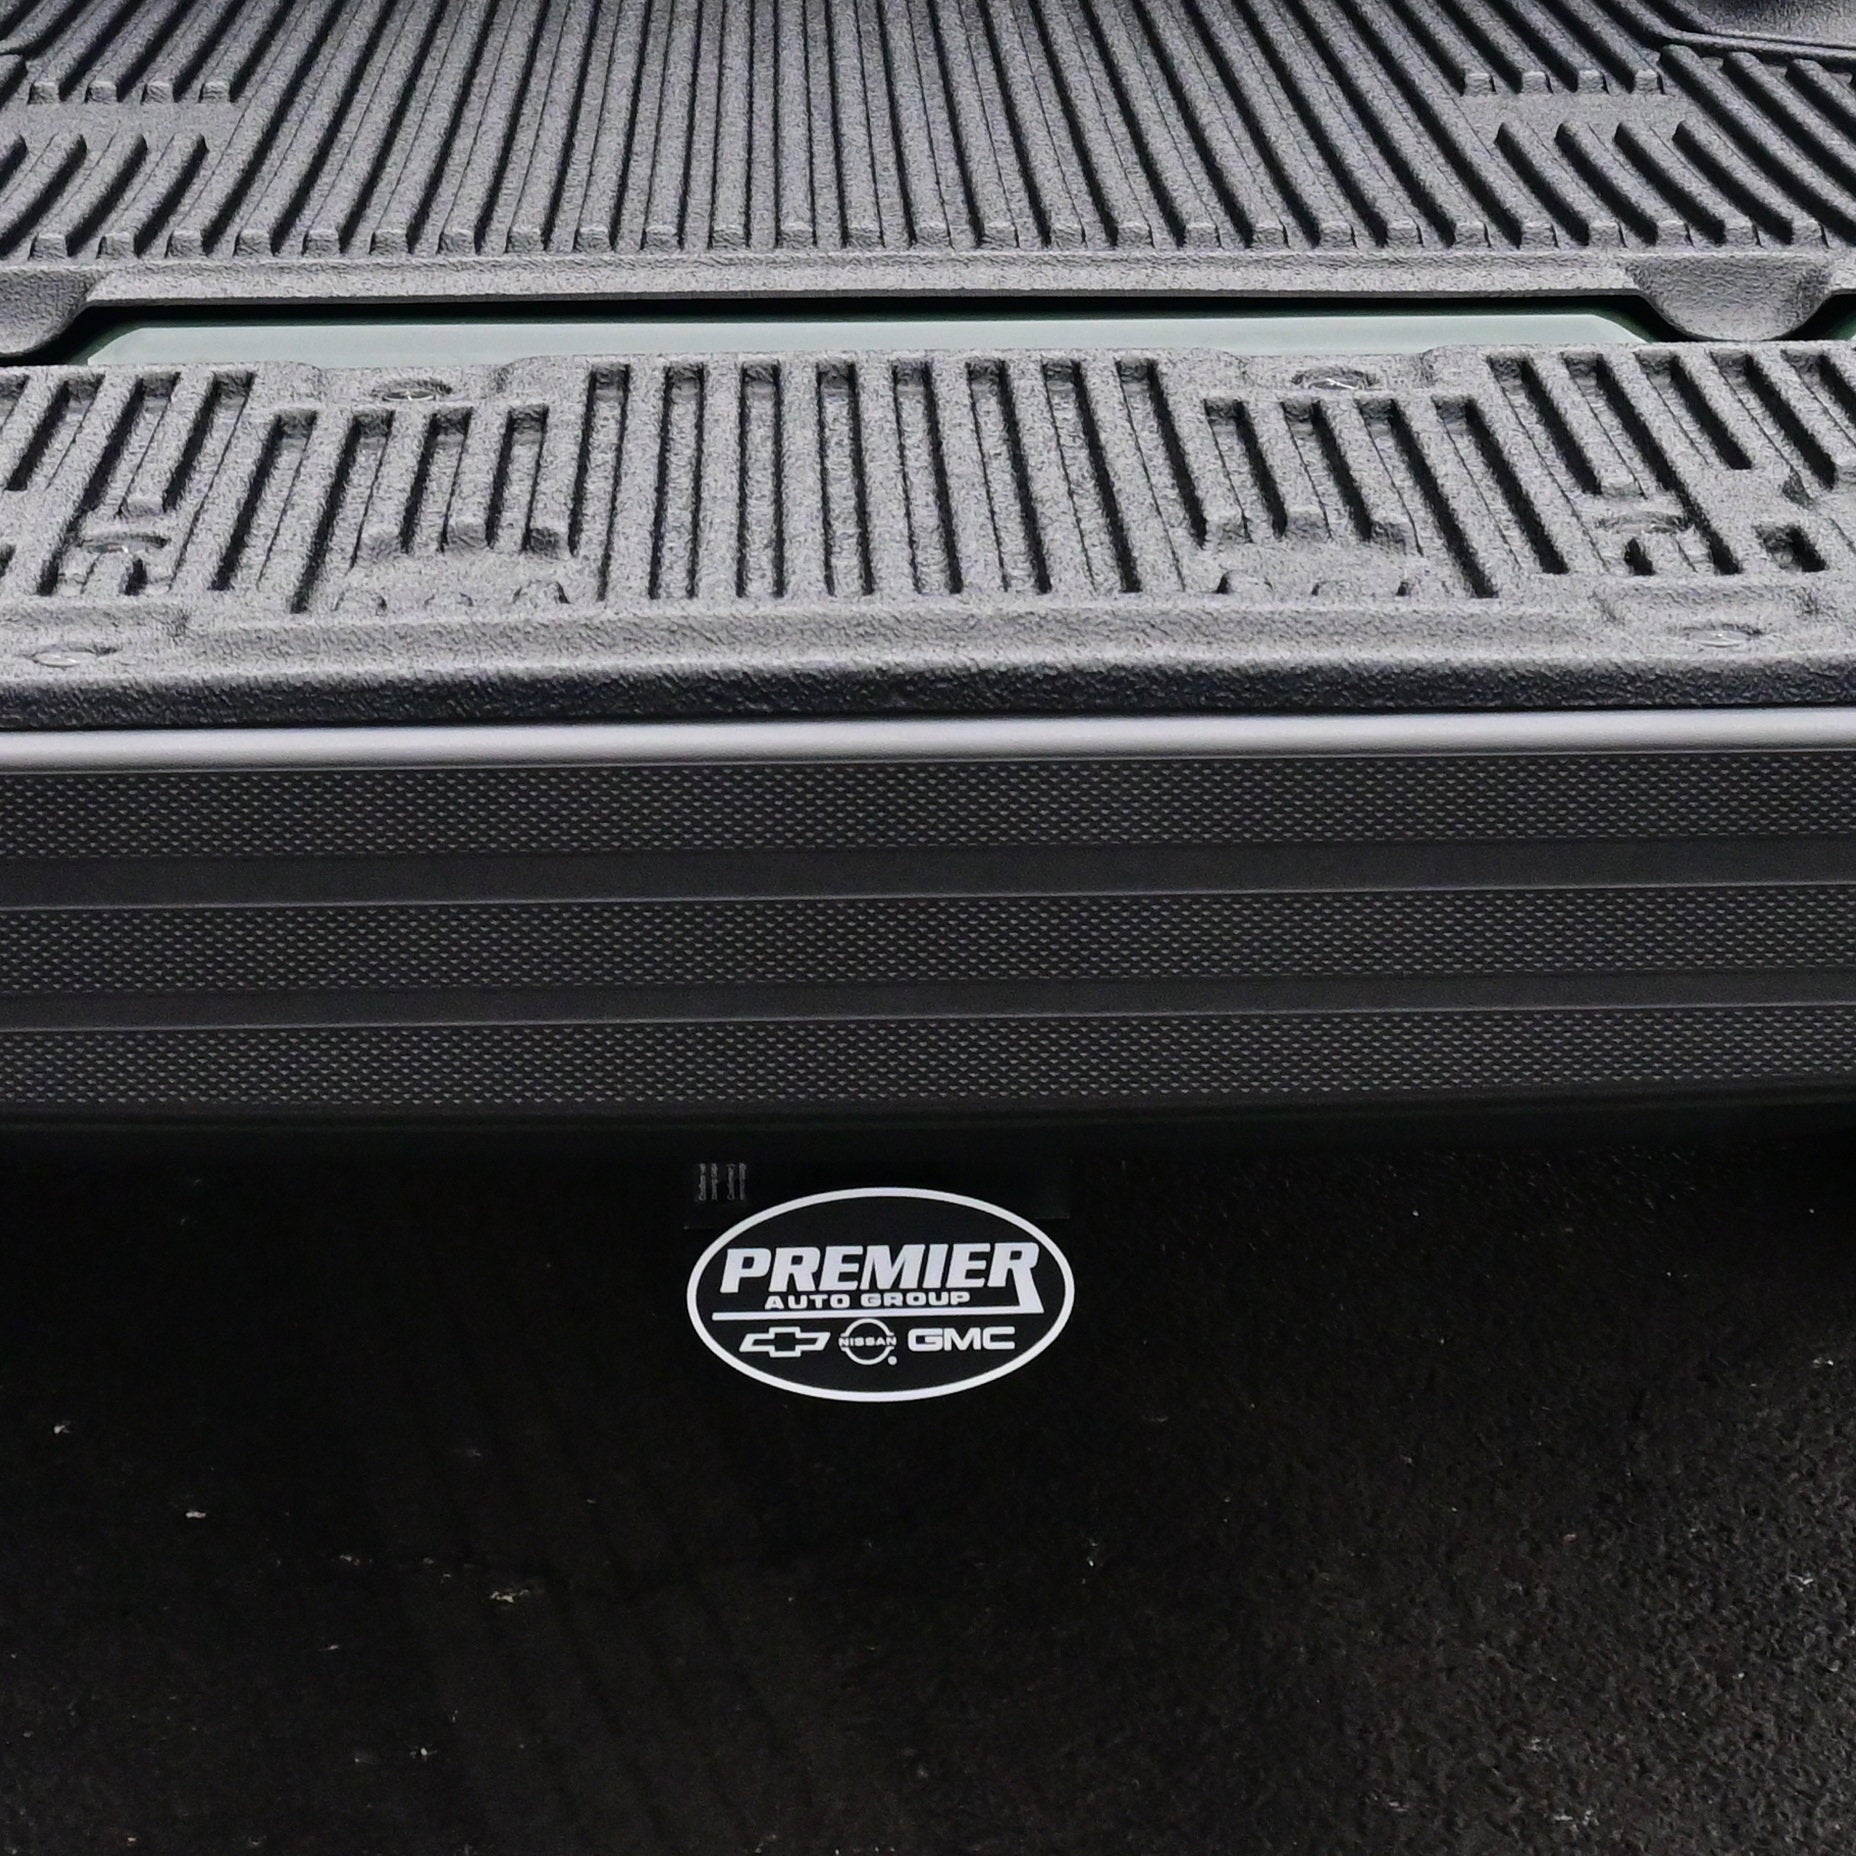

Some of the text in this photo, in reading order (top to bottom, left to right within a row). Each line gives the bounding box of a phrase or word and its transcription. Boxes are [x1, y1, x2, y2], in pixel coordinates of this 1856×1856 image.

[720, 1242, 1044, 1313] PREMIER
[764, 1291, 970, 1310] AUTO GROUP
[838, 1326, 1016, 1352] NISSAN GMC
